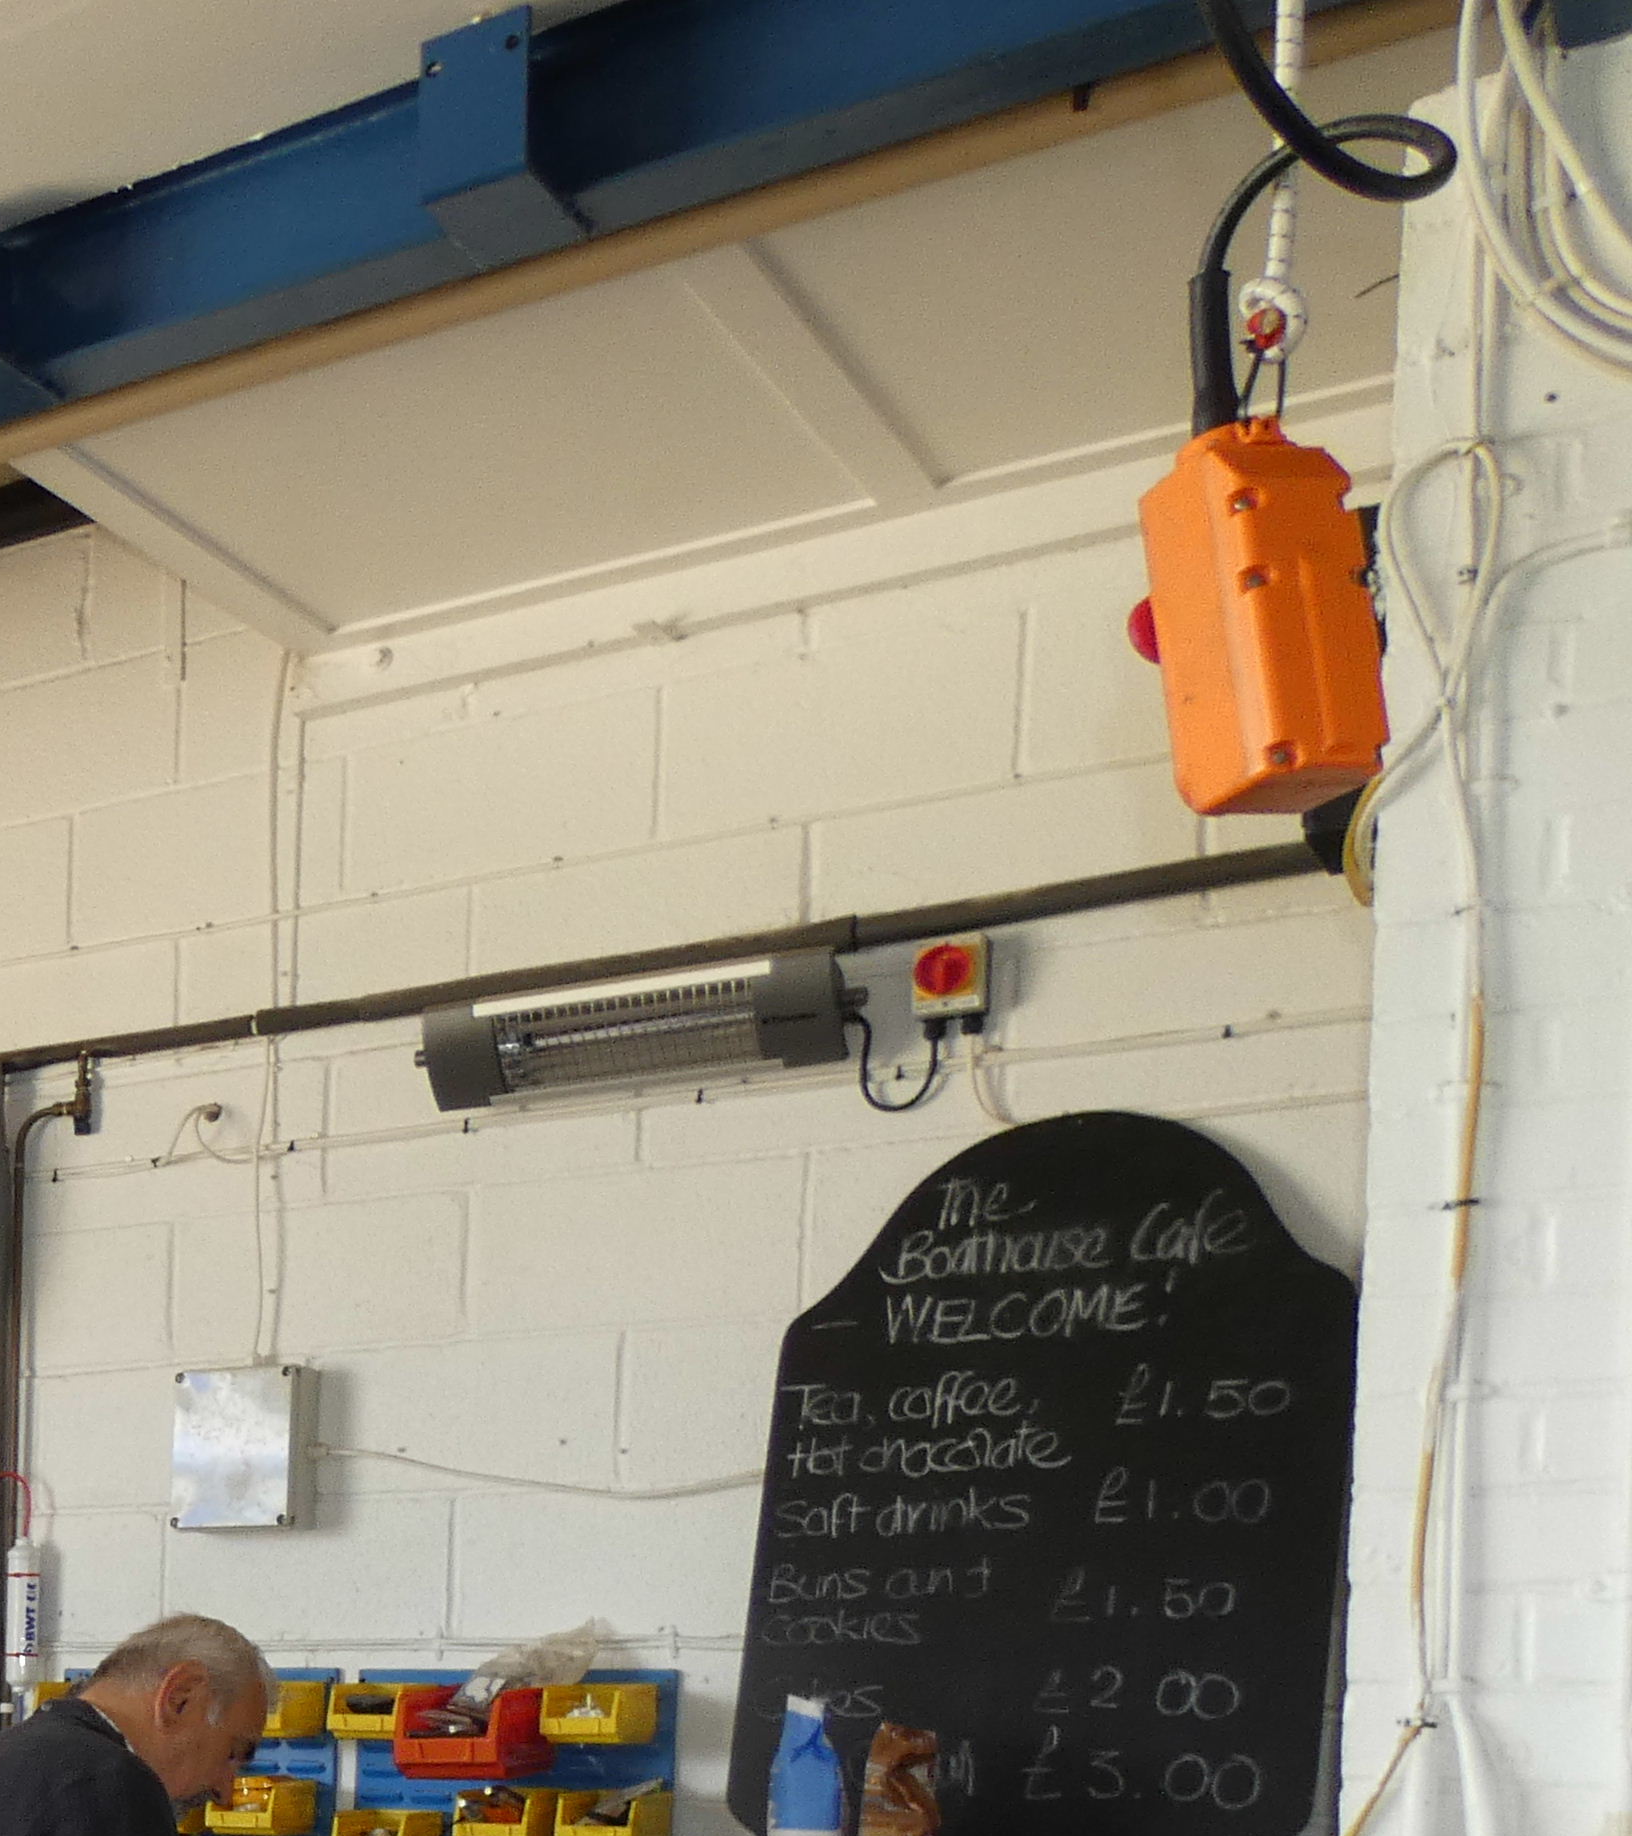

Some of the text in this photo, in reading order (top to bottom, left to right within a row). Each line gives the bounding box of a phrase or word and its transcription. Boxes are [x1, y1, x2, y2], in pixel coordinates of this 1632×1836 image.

[938, 1177, 1038, 1229] The
[881, 1225, 1110, 1284] Boathouse
[886, 1268, 1175, 1344] WELCOME!
[787, 1418, 1073, 1479] Hot chocolate
[774, 1466, 1274, 1539] Soft drinks £1.00
[25, 1605, 36, 1642] BWT
[1022, 1724, 1265, 1812] £3.00
